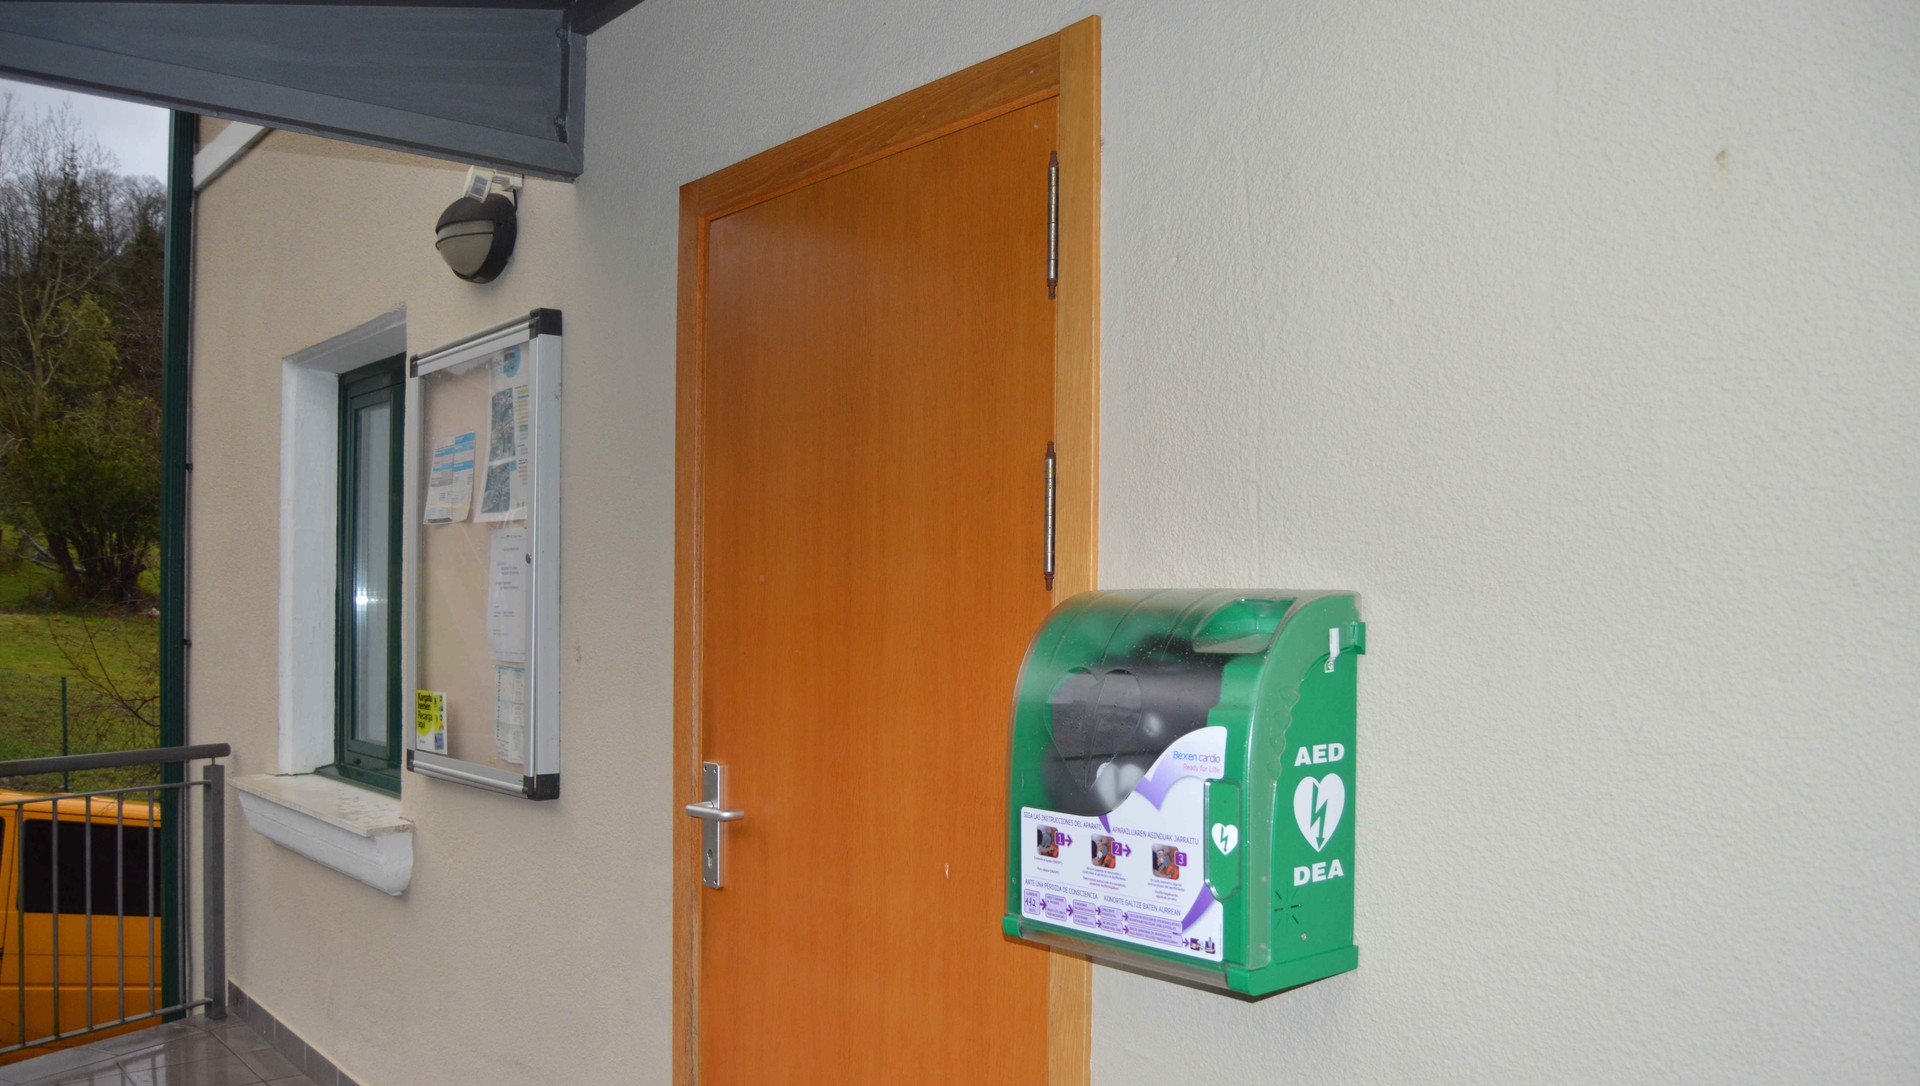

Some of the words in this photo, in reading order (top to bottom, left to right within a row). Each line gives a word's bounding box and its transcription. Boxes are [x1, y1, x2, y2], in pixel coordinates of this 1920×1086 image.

[1173, 750, 1198, 761] Bexen
[1198, 753, 1221, 764] cardio
[1294, 742, 1345, 767] AED
[1183, 763, 1199, 772] Ready
[1200, 764, 1208, 772] for
[1023, 811, 1033, 819] SIGA
[1041, 814, 1074, 827] INSTRUCCIONES
[1074, 820, 1082, 828] DEL
[1083, 821, 1103, 831] APARATO
[1058, 834, 1064, 844] 1
[1114, 843, 1121, 855] 2
[1178, 853, 1185, 865] 3
[1293, 858, 1345, 887] DEA
[1025, 878, 1035, 886] ANTE
[1036, 880, 1044, 888] UNA
[1062, 886, 1068, 894] DE
[1068, 888, 1098, 900] CONSCIENCIA
[1025, 897, 1037, 908] 112
[1103, 895, 1125, 906] KONORTE
[1125, 898, 1142, 909] GALTZE
[1142, 902, 1158, 912] BATEN
[1158, 906, 1182, 917] AURREAN
